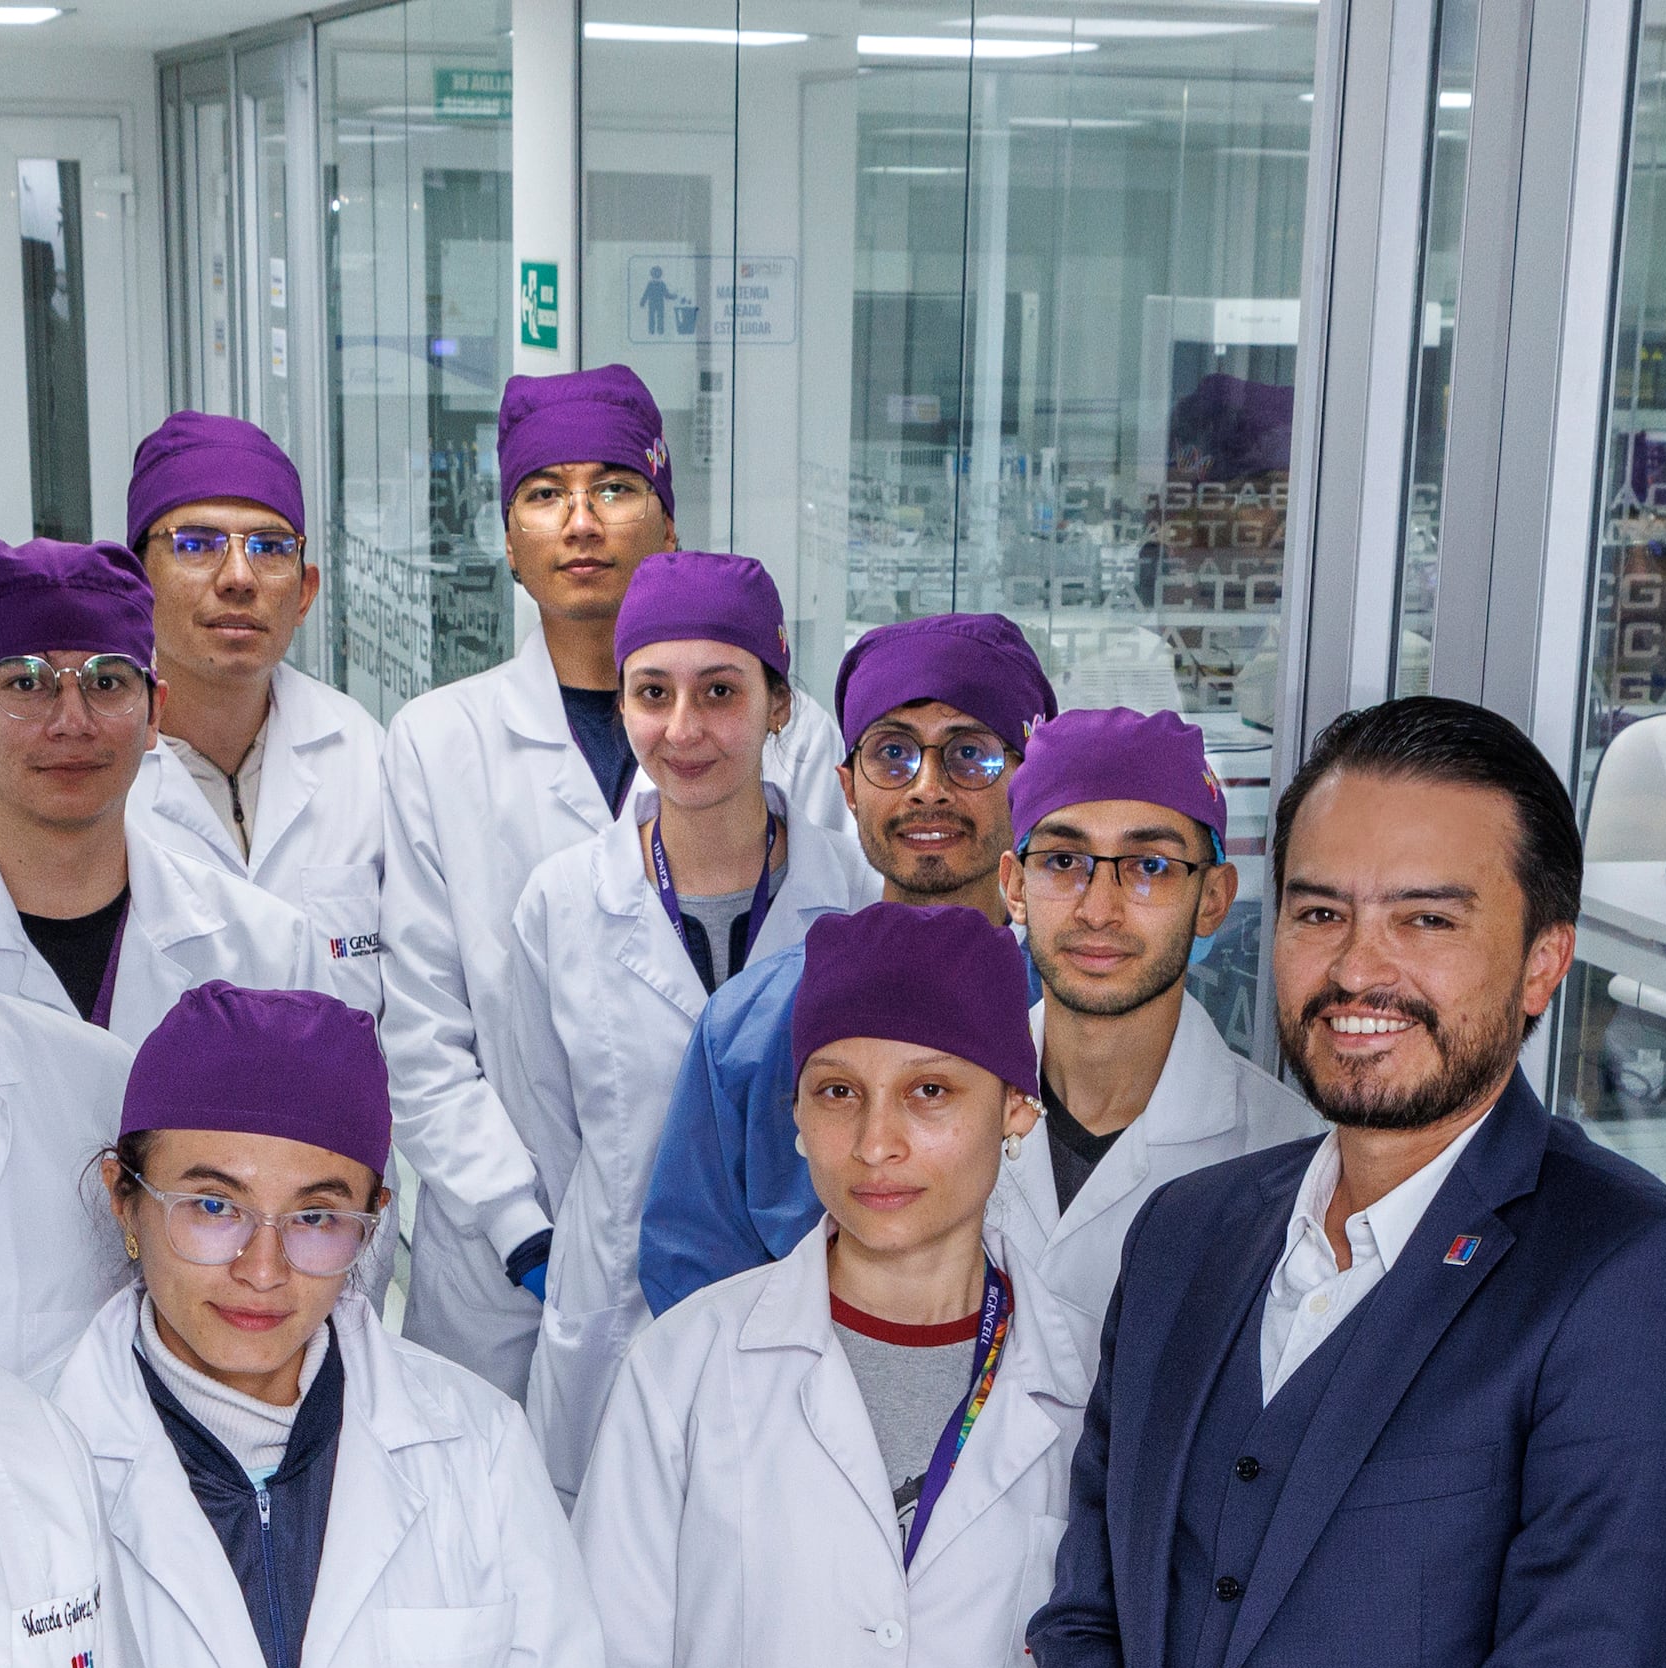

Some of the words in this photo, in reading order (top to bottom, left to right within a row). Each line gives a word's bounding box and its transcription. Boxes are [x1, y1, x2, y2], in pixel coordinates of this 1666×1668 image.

[717, 286, 769, 300] MATENGA
[714, 322, 737, 335] EST
[980, 1294, 998, 1345] GENCELL
[22, 1606, 63, 1638] Marcela
